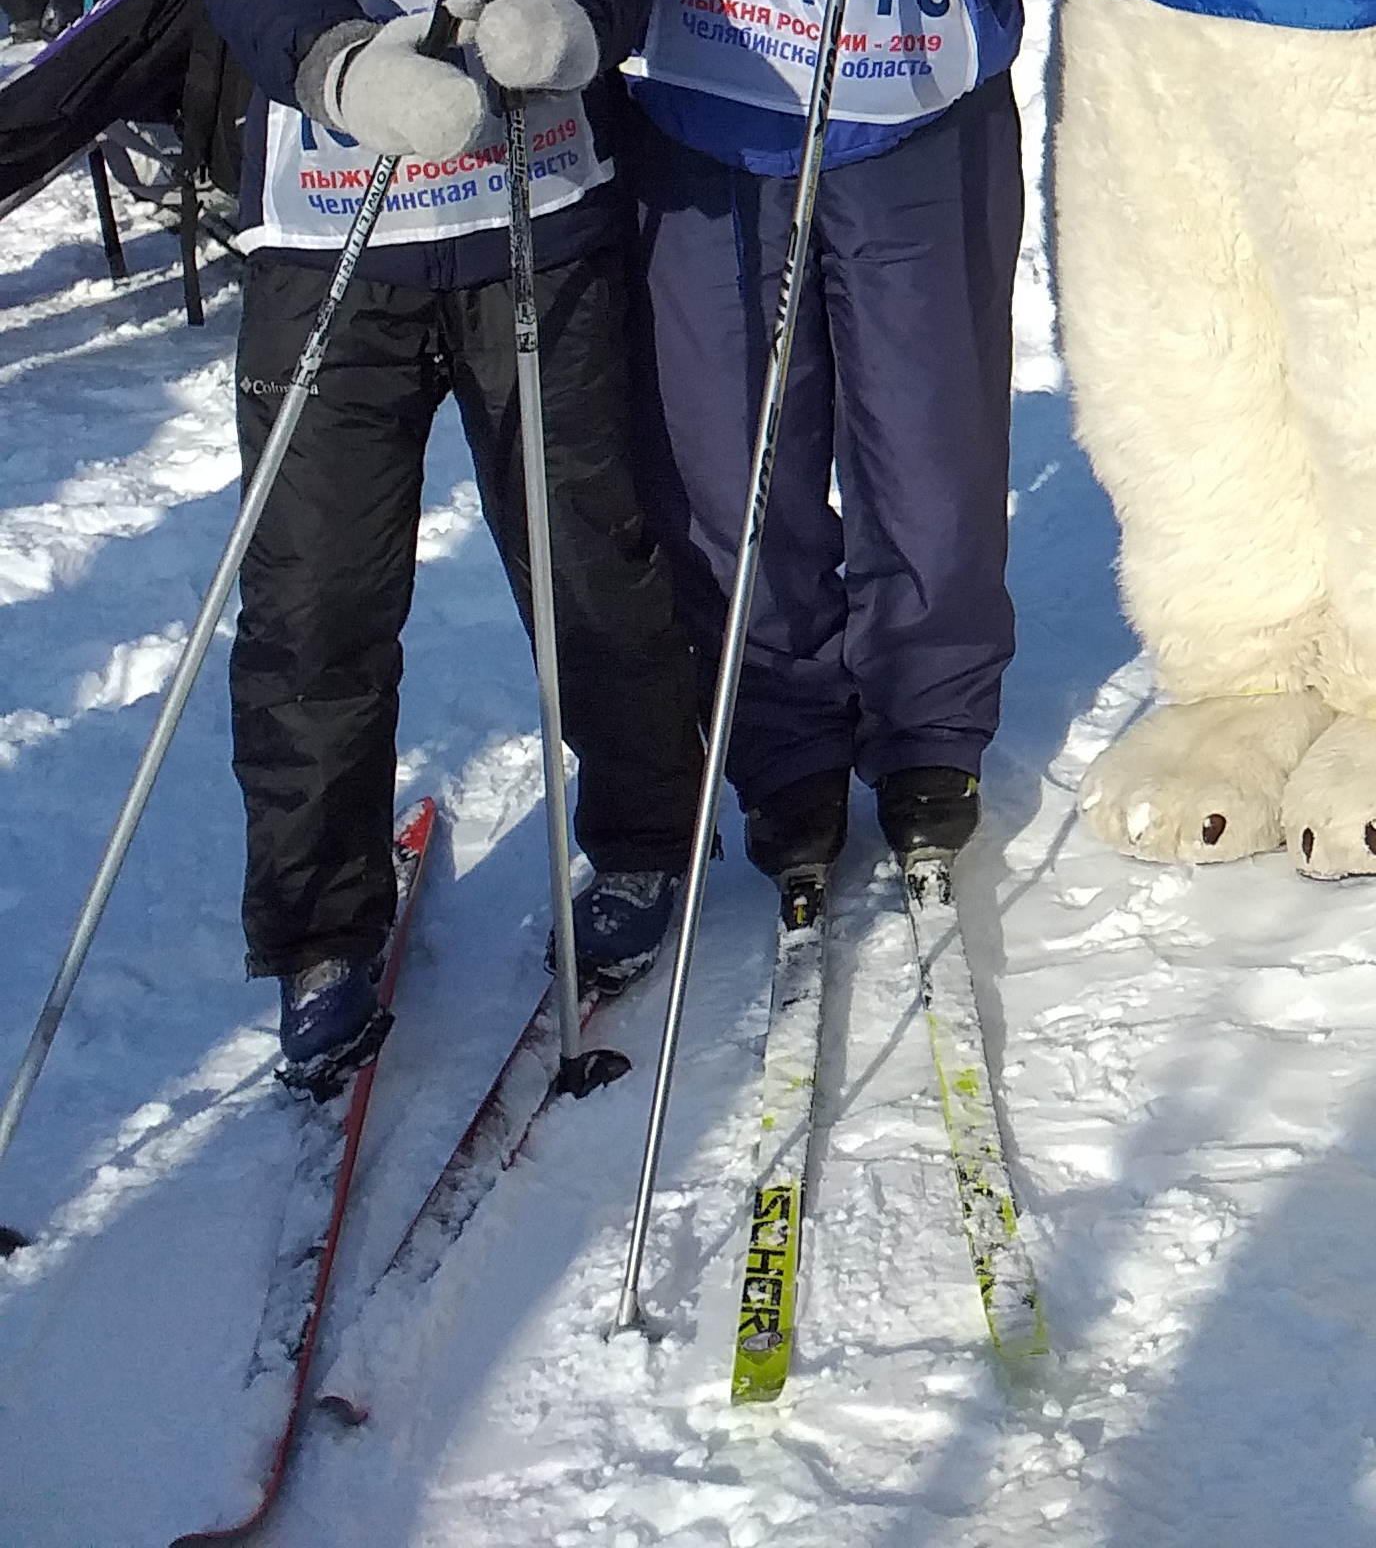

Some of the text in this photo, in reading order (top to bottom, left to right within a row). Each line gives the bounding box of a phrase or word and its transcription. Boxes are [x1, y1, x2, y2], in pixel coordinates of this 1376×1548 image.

[681, 12, 934, 79] Челябинска область
[777, 15, 867, 53] РОСИИ
[888, 34, 943, 53] 2019
[532, 119, 578, 152] 2019
[737, 1185, 793, 1333] ISCHER
